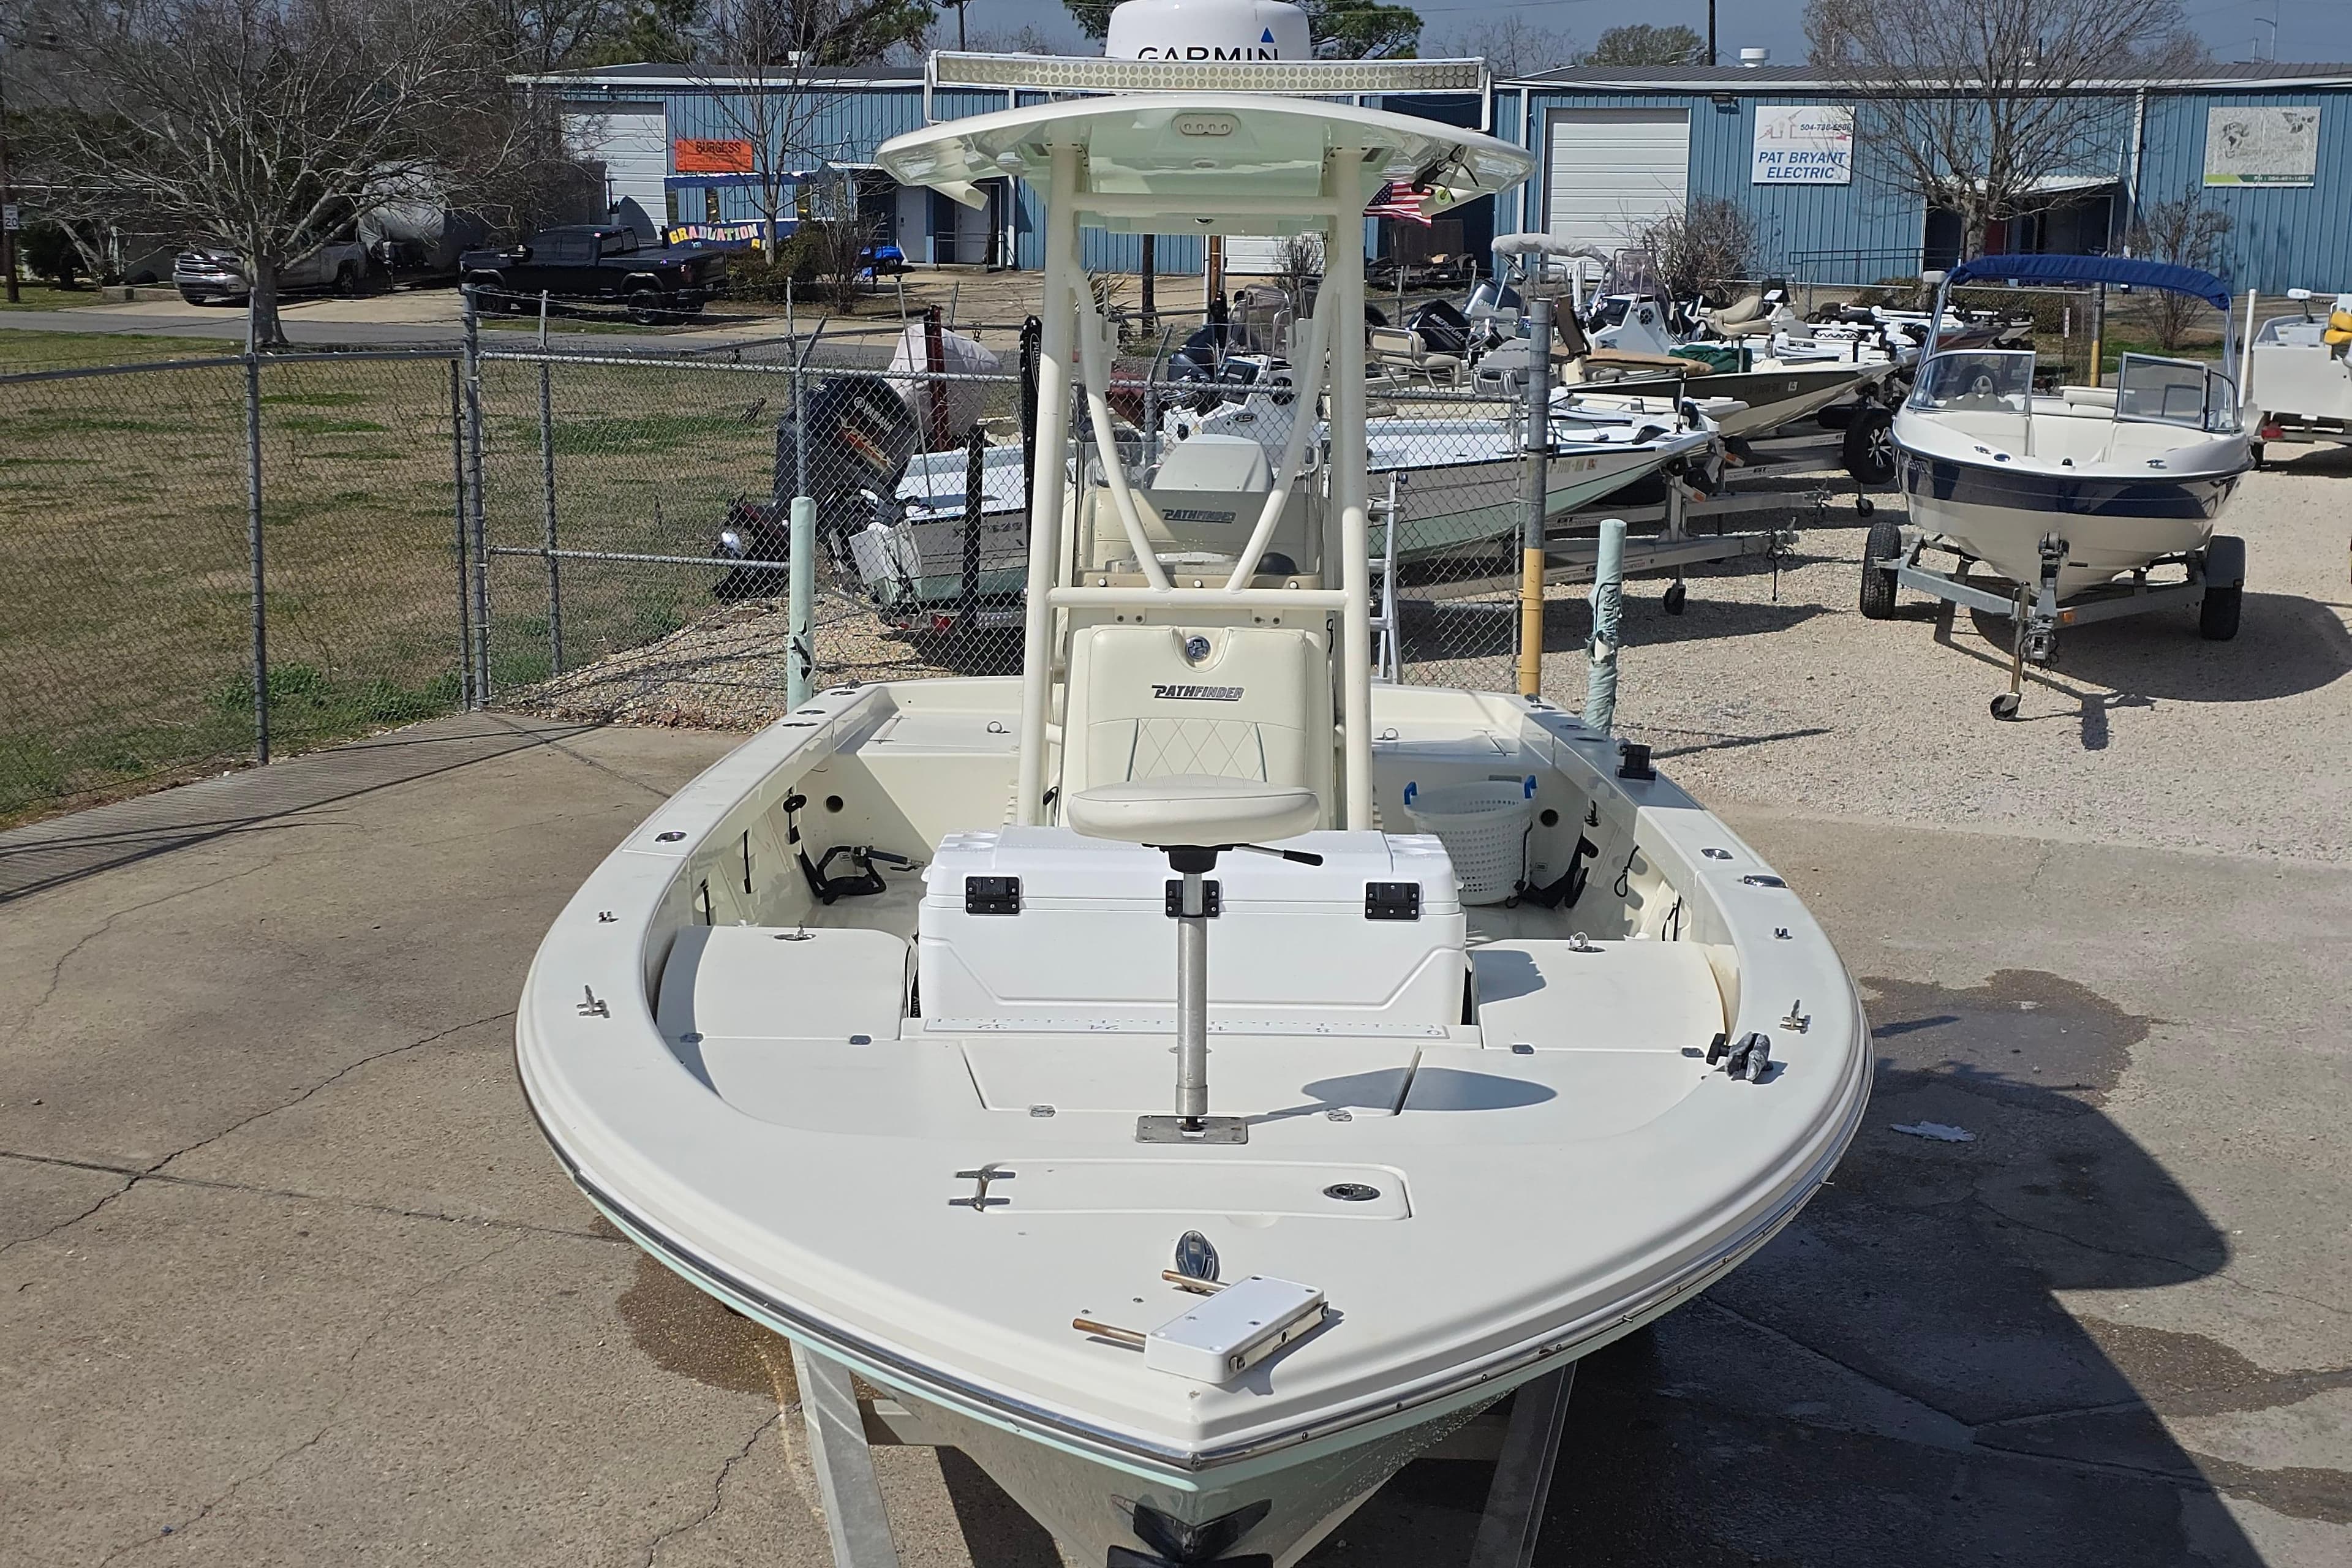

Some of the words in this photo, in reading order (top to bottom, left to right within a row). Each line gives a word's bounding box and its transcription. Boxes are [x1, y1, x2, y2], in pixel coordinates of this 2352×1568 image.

[1137, 47, 1279, 61] GARMIN
[696, 141, 741, 154] BURGESS
[1758, 152, 1785, 164] PAT
[1789, 152, 1846, 164] BRYANT
[1767, 167, 1834, 179] ELECTRIC
[5, 217, 18, 227] 20
[669, 223, 758, 244] GRADUATION
[1429, 313, 1468, 342] MERCURY
[864, 402, 894, 432] YAMAHA
[1161, 509, 1237, 524] PATHFINDER
[1152, 685, 1245, 701] PATHFINDER
